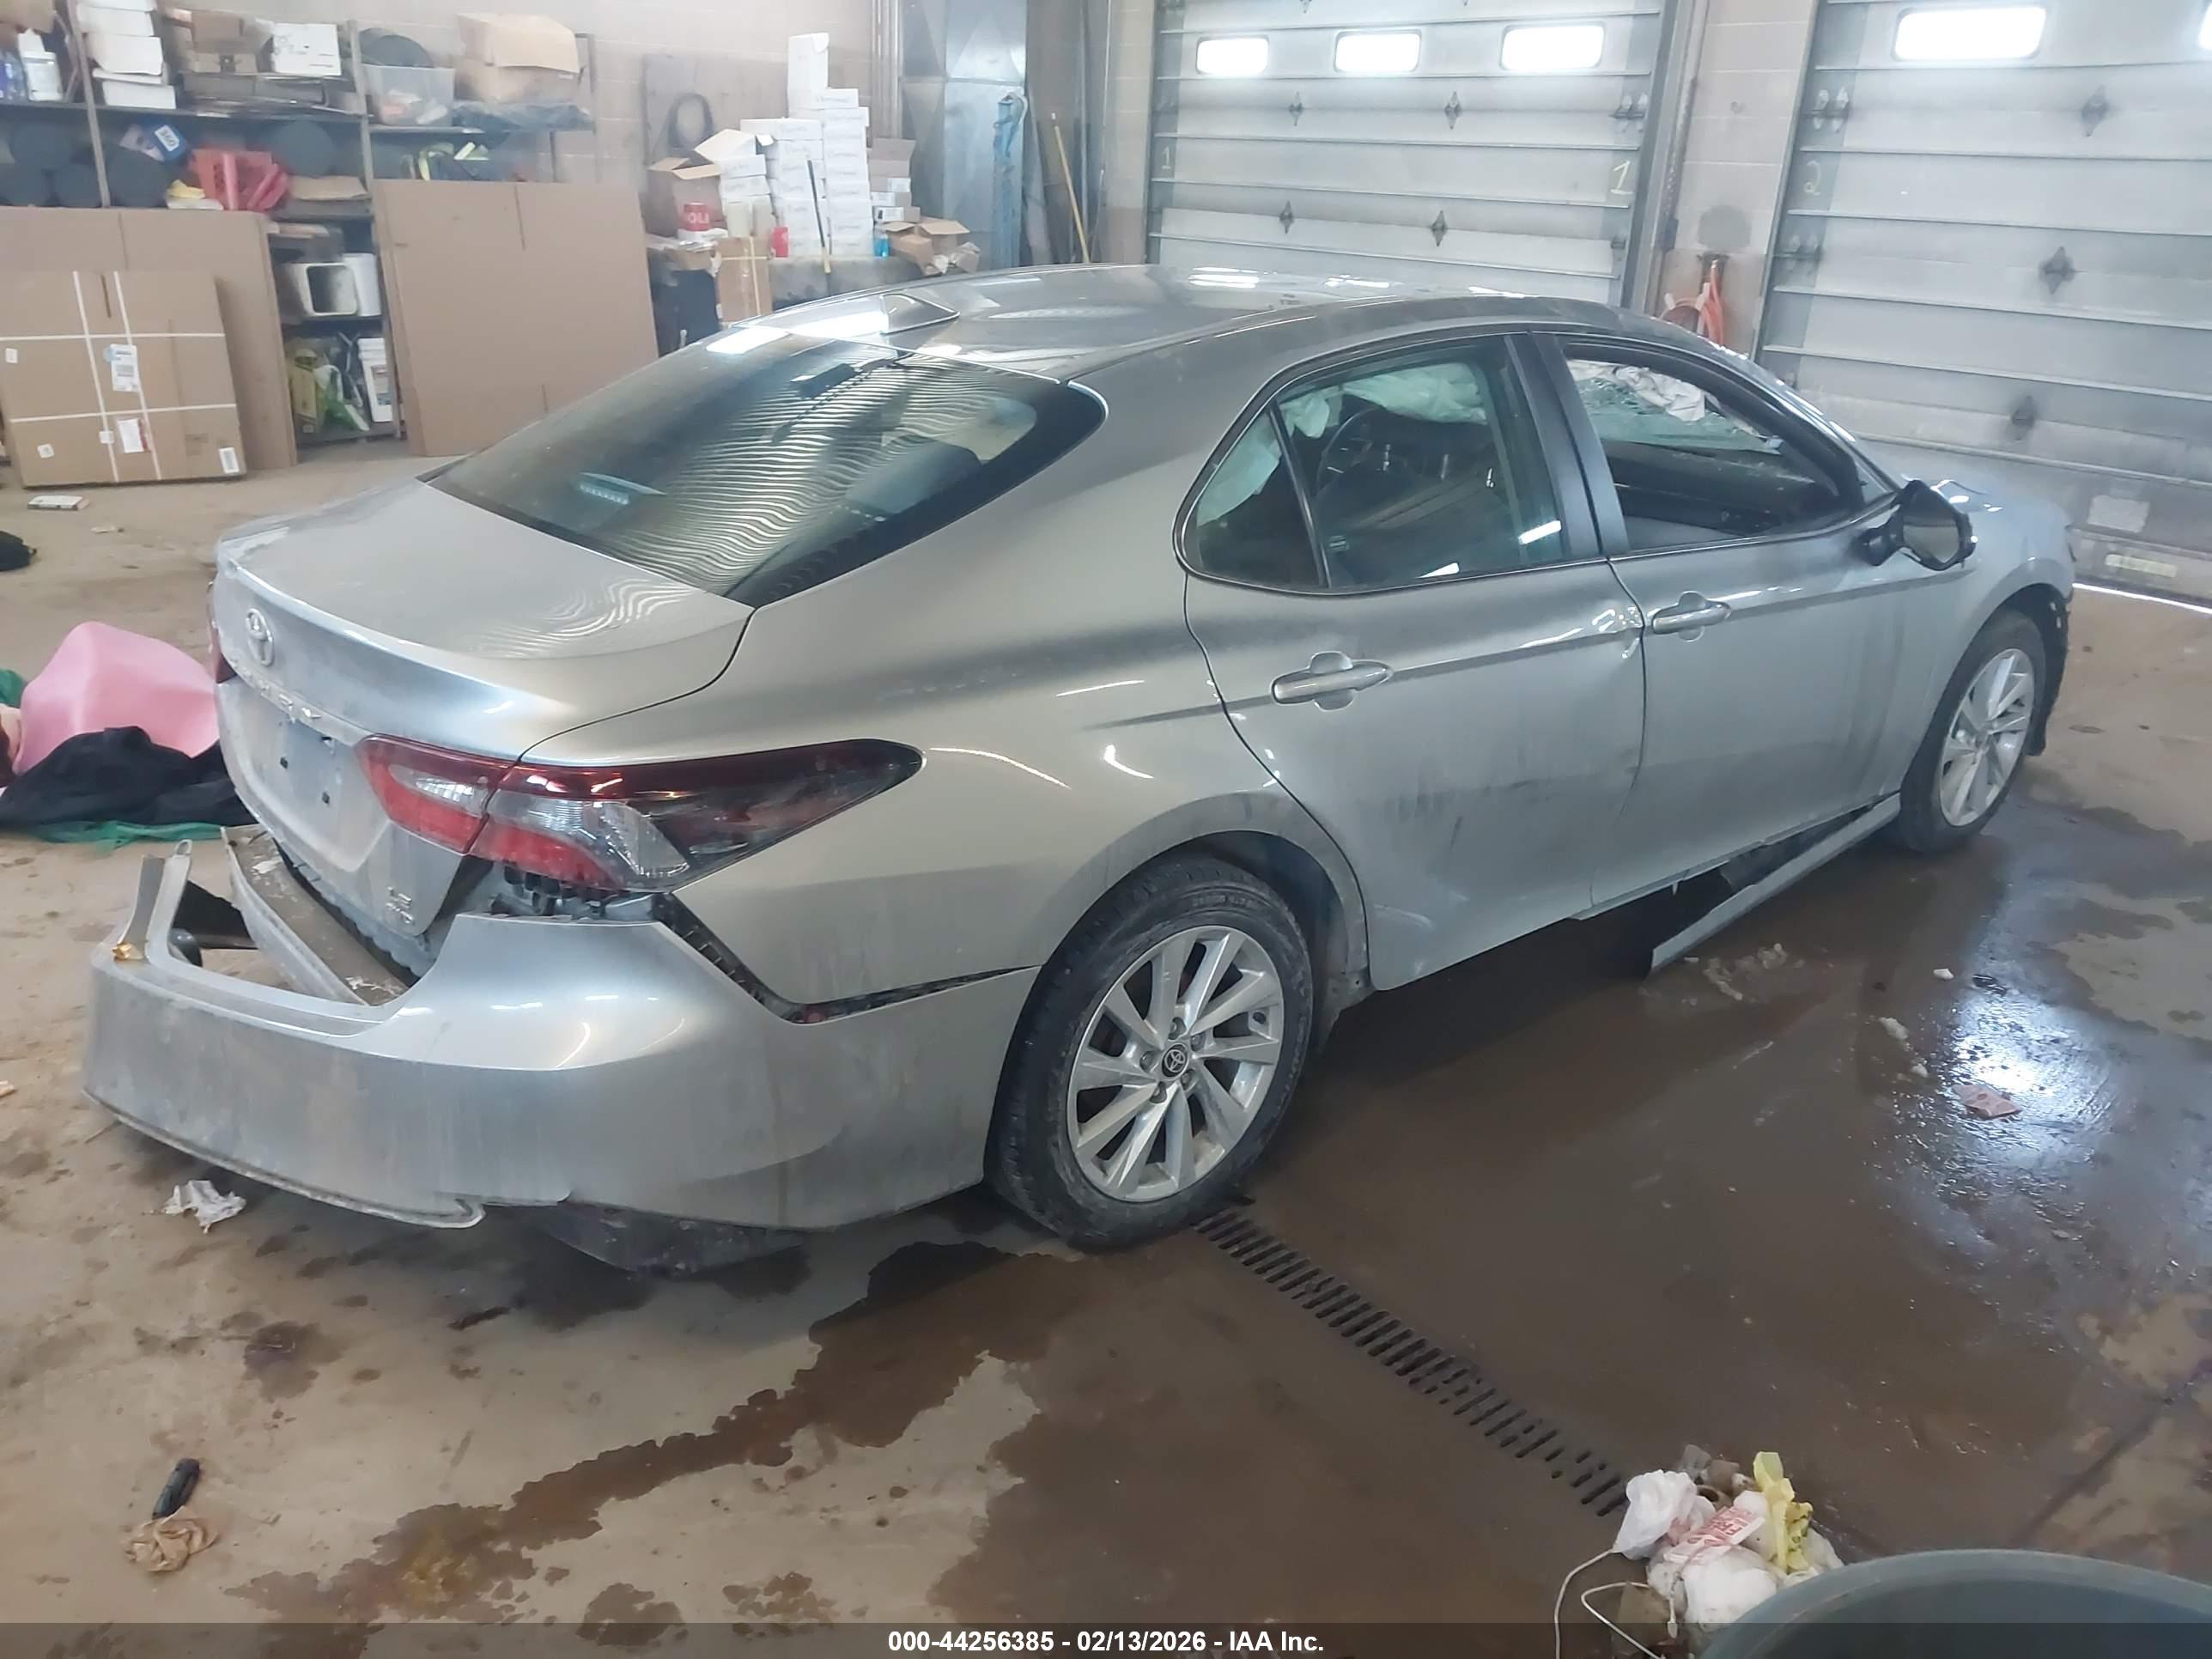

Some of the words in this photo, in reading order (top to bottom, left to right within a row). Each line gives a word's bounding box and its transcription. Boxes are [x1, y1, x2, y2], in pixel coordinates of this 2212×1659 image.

[1161, 146, 1172, 170] 1
[1609, 160, 1634, 196] 1
[1803, 160, 1821, 197] 2
